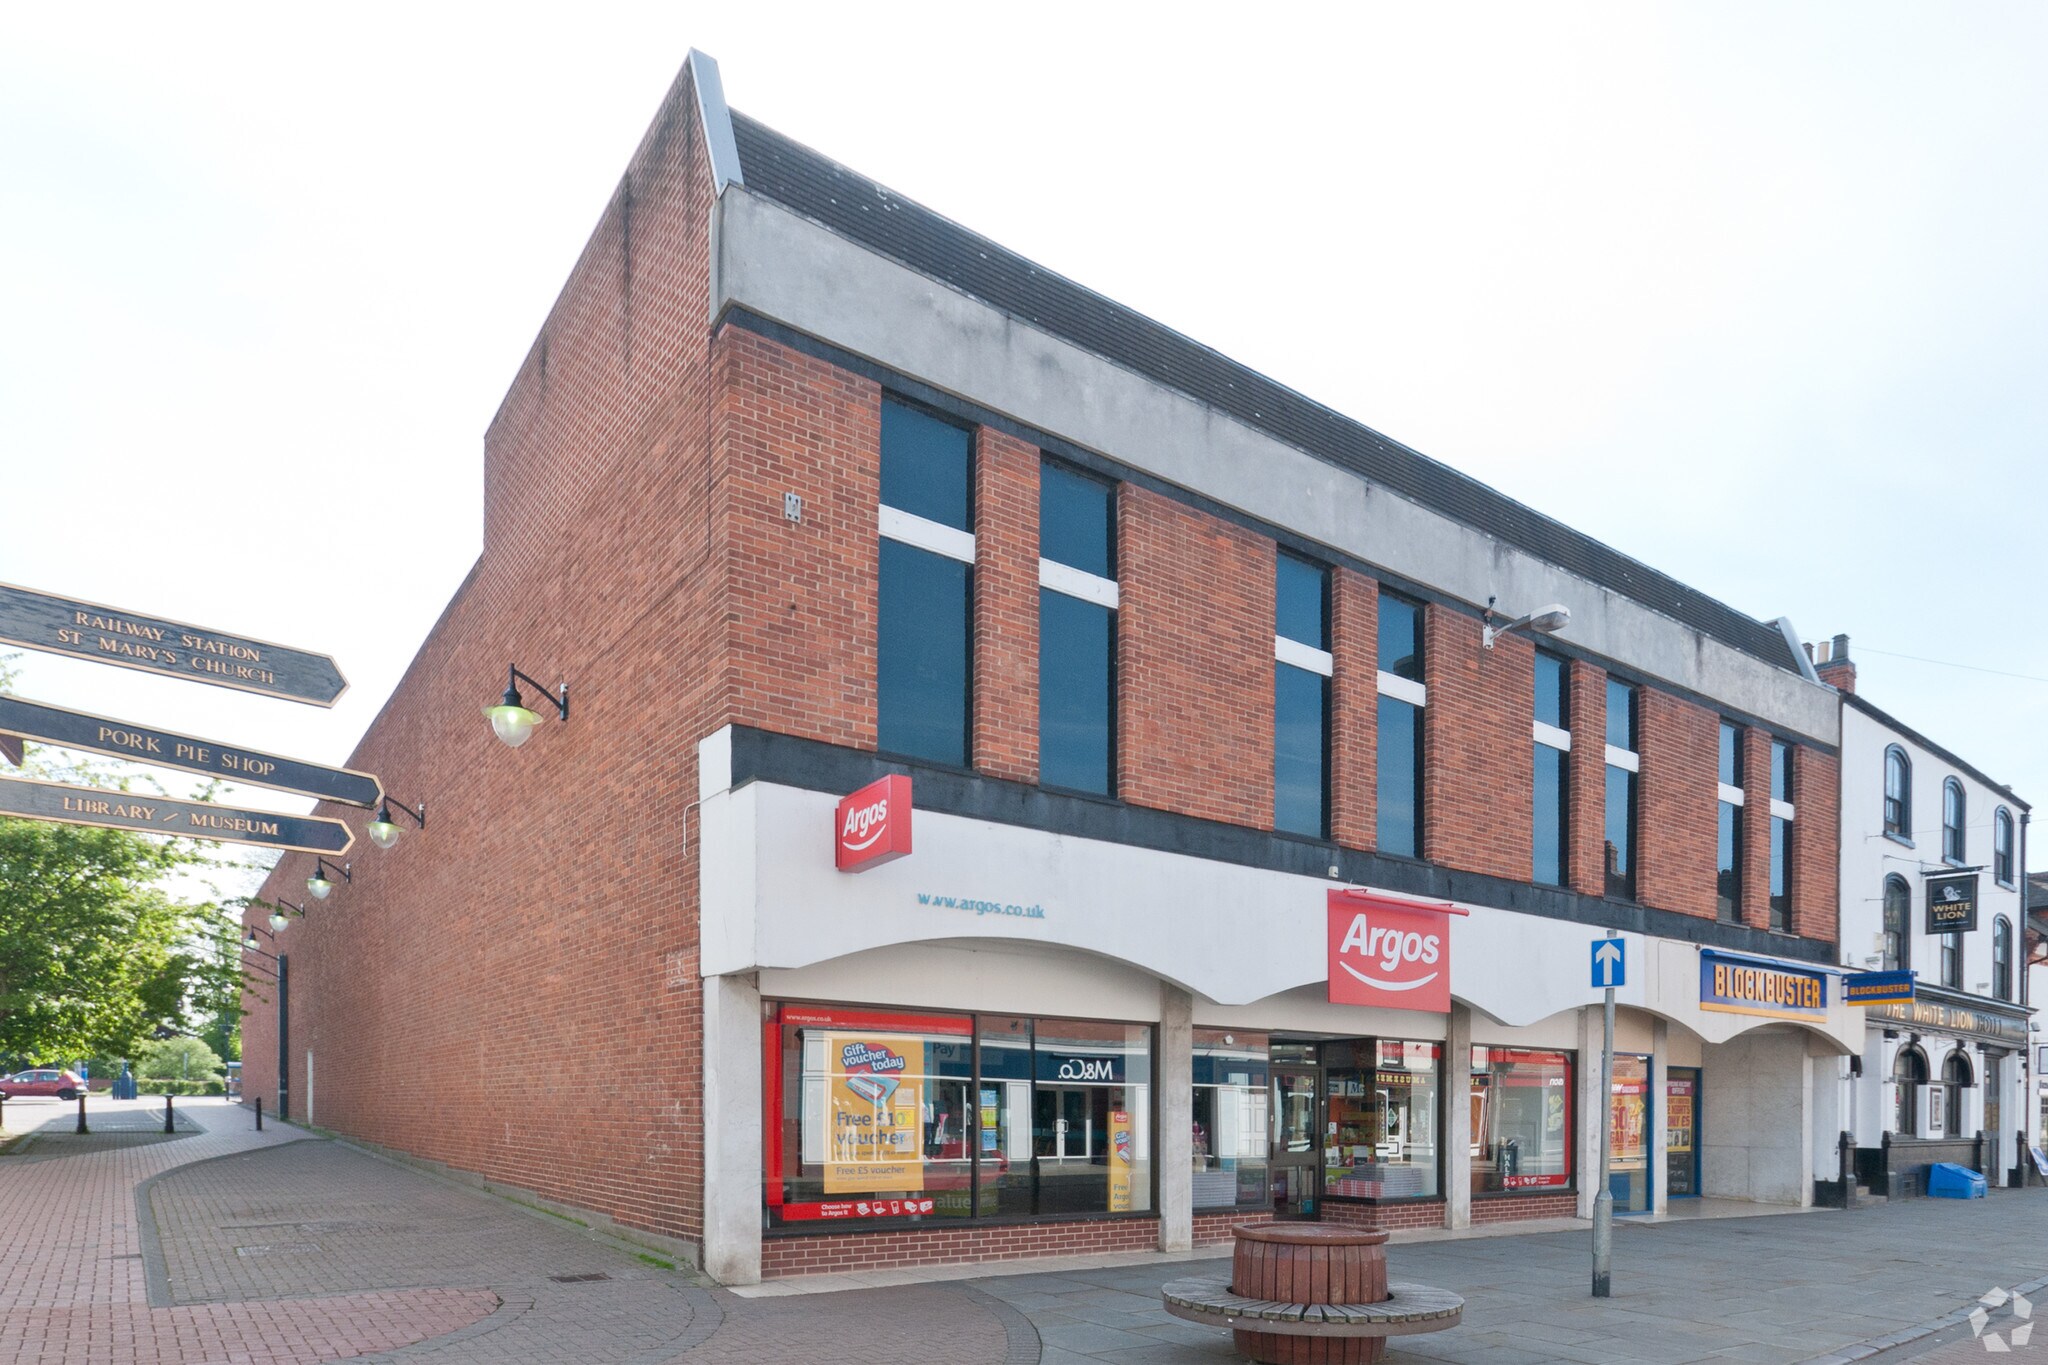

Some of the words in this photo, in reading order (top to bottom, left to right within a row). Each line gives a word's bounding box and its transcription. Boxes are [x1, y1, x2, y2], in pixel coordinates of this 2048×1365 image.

[76, 611, 165, 642] RAILWAY
[182, 634, 260, 663] STATION
[58, 629, 84, 645] ST
[100, 636, 176, 664] MARY'S
[192, 657, 275, 685] CHURCH
[99, 726, 161, 753] PORK
[176, 743, 210, 763] PIE
[222, 753, 275, 776] SHOP
[63, 797, 156, 820] LIBRARY
[190, 812, 278, 836] MUSEUM
[842, 797, 887, 838] Argos
[917, 893, 1045, 920] www.argos.co.uk
[1933, 902, 1971, 913] WHITE
[1937, 911, 1966, 920] LION
[1339, 914, 1440, 973] Argos
[1714, 964, 1821, 1008] BLOCKBUSTER
[1850, 984, 1910, 995] BLOCKBUSTER
[1886, 1004, 1906, 1019] THE
[1913, 1003, 1945, 1025] WHITE
[1951, 1009, 1973, 1030] LION
[842, 1050, 887, 1066] voucher
[843, 1043, 866, 1057] Gift
[933, 1043, 955, 1057] Pay
[871, 1057, 905, 1072] today
[837, 1111, 871, 1126] Free
[837, 1129, 905, 1145] voucher
[836, 1166, 855, 1176] Free
[858, 1166, 869, 1176] £5
[871, 1166, 905, 1175] voucher
[936, 1195, 971, 1210] alue
